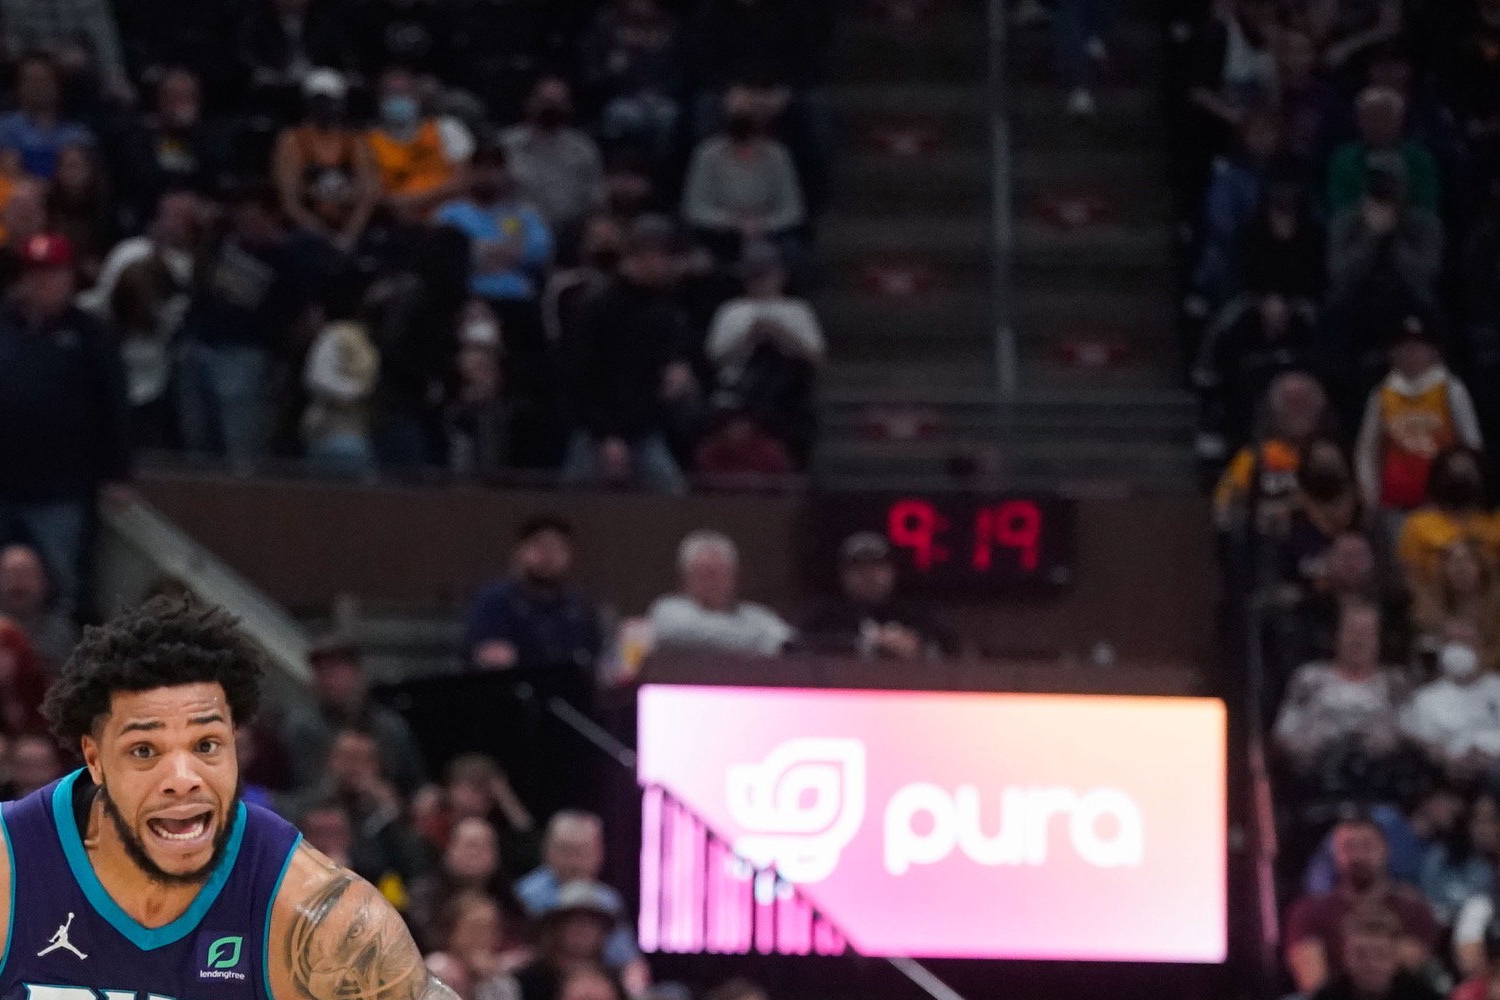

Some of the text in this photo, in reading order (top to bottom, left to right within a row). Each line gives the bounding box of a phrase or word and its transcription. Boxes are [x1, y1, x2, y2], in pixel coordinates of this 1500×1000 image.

[889, 499, 1041, 571] 9:19
[883, 781, 1145, 876] pura
[200, 970, 245, 980] lendingtree
